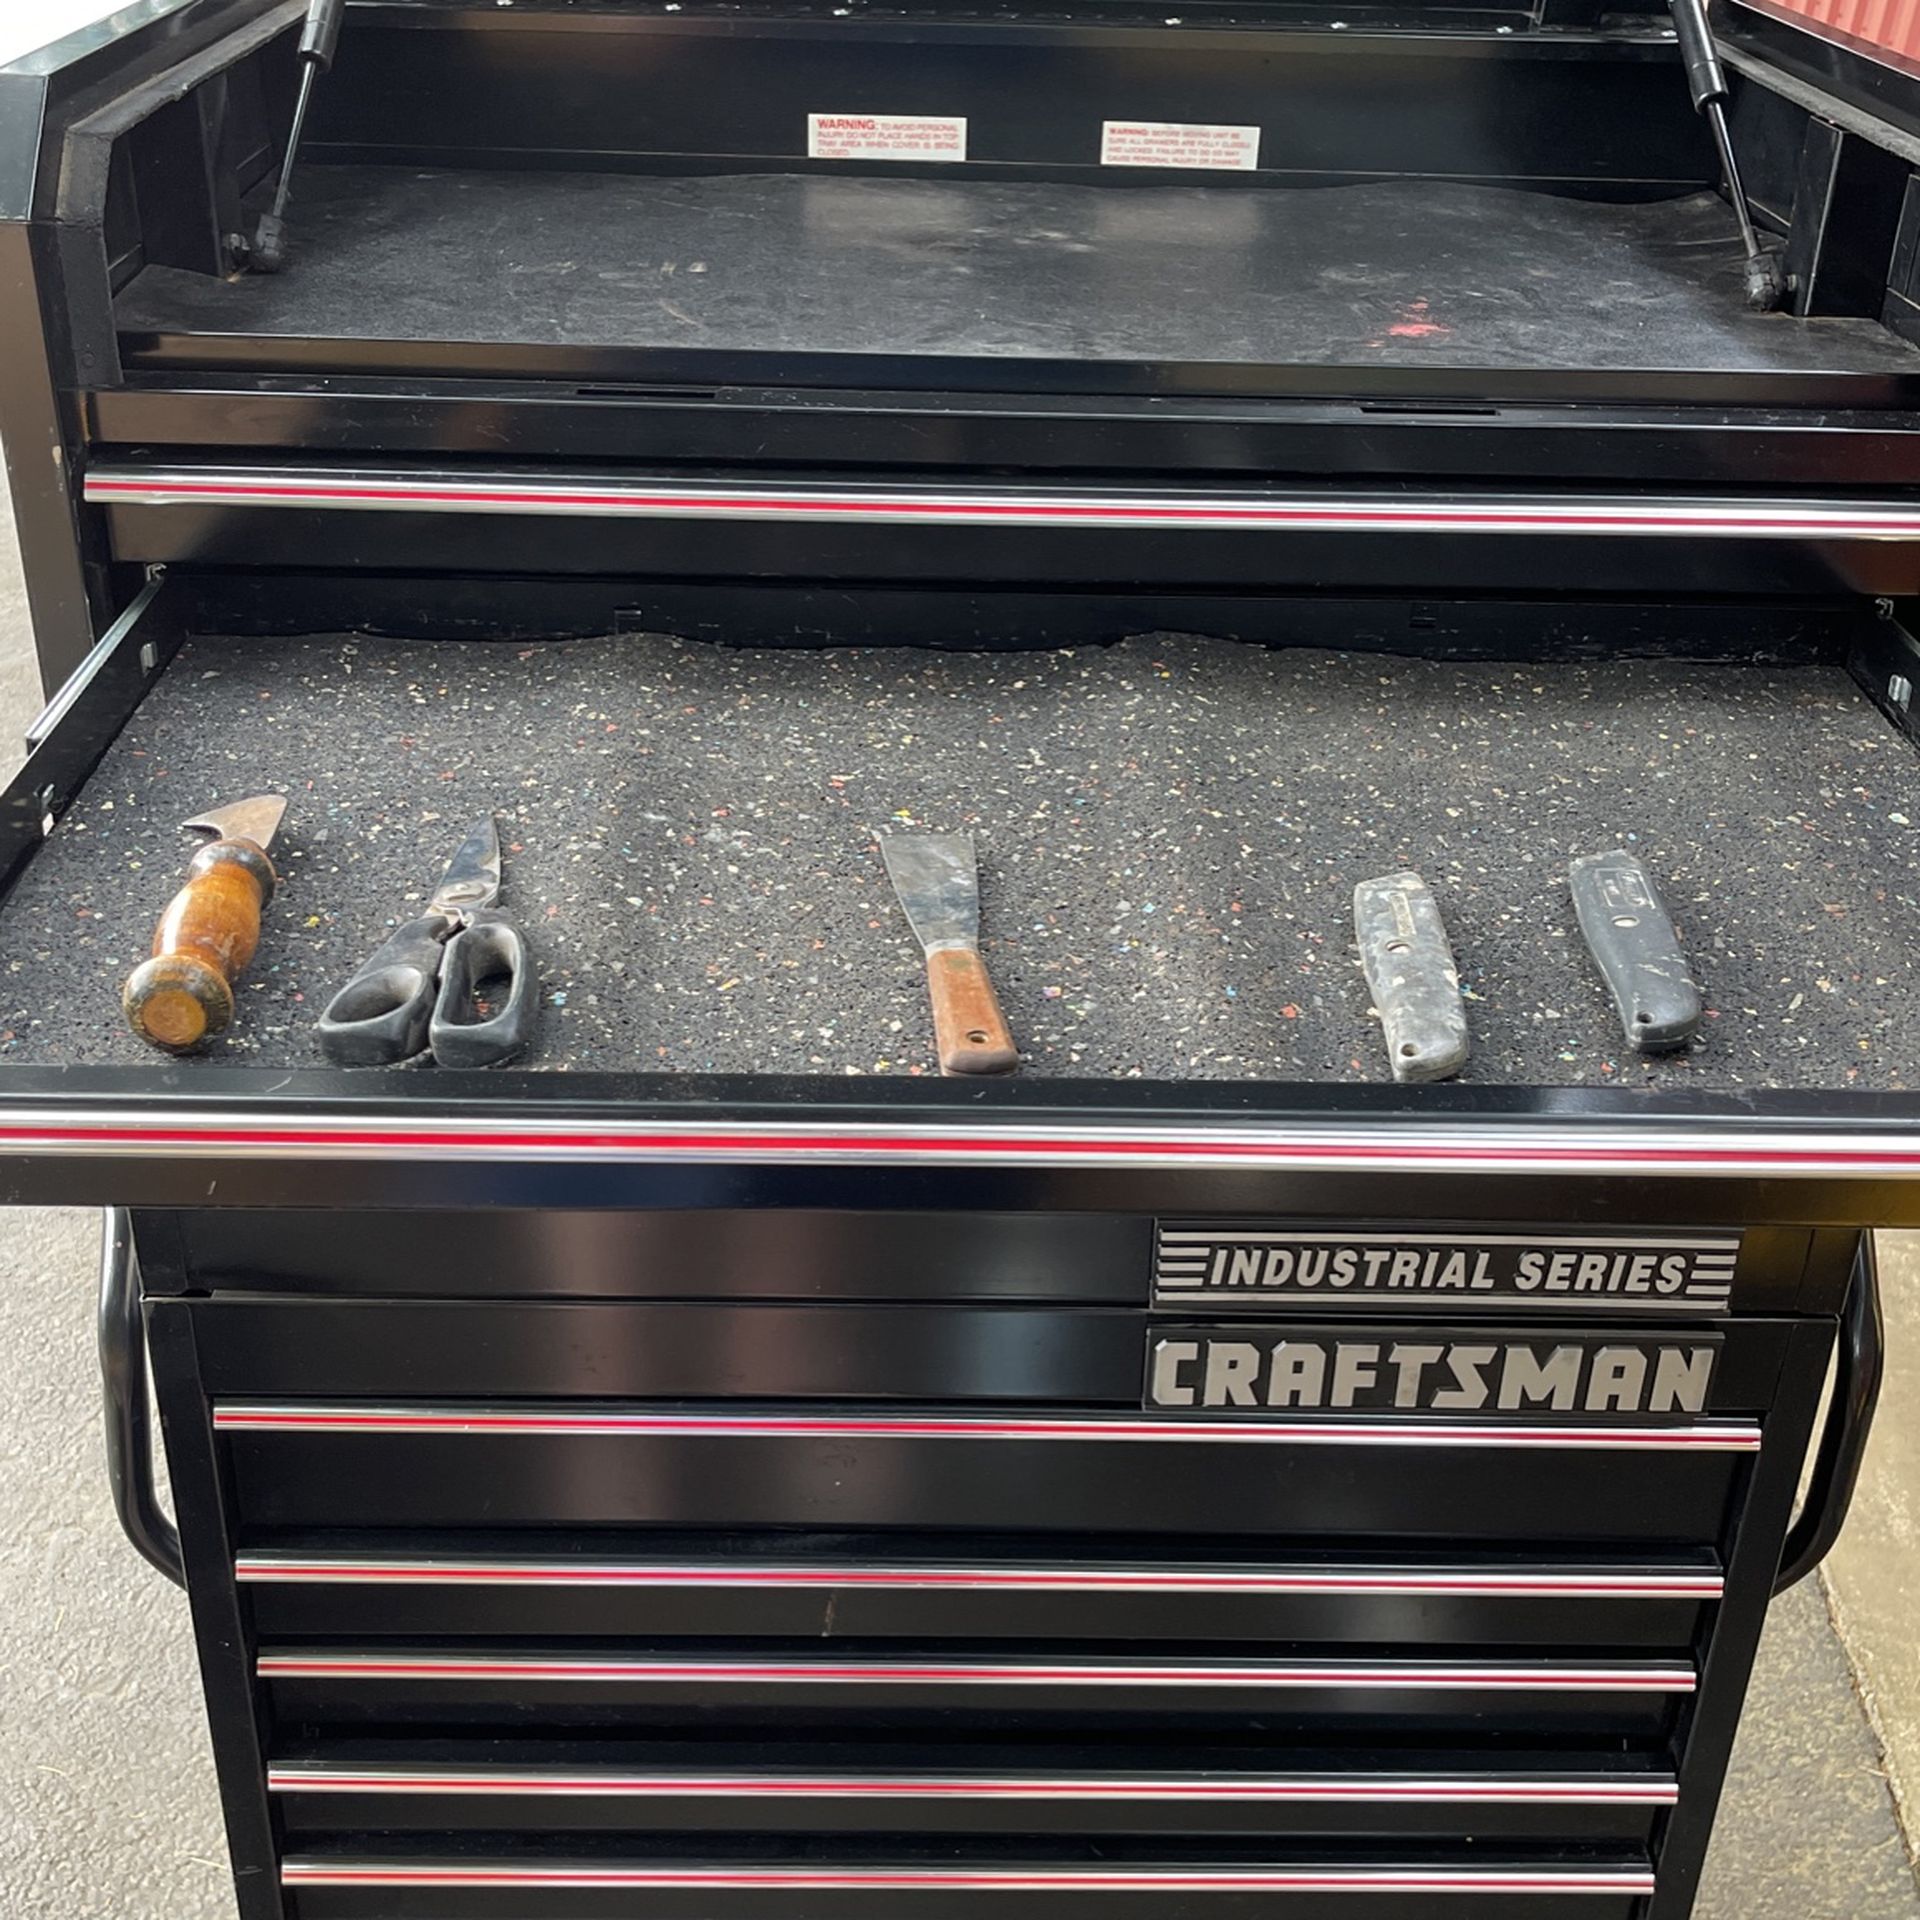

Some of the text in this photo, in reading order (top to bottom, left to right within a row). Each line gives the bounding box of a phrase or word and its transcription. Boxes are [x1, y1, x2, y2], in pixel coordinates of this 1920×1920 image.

[917, 124, 958, 132] PERSONAL
[840, 140, 862, 148] AREA
[1208, 1245, 1688, 1294] INDUSTRIAL SERIES
[1151, 1338, 1715, 1412] CRAFTSMAN
